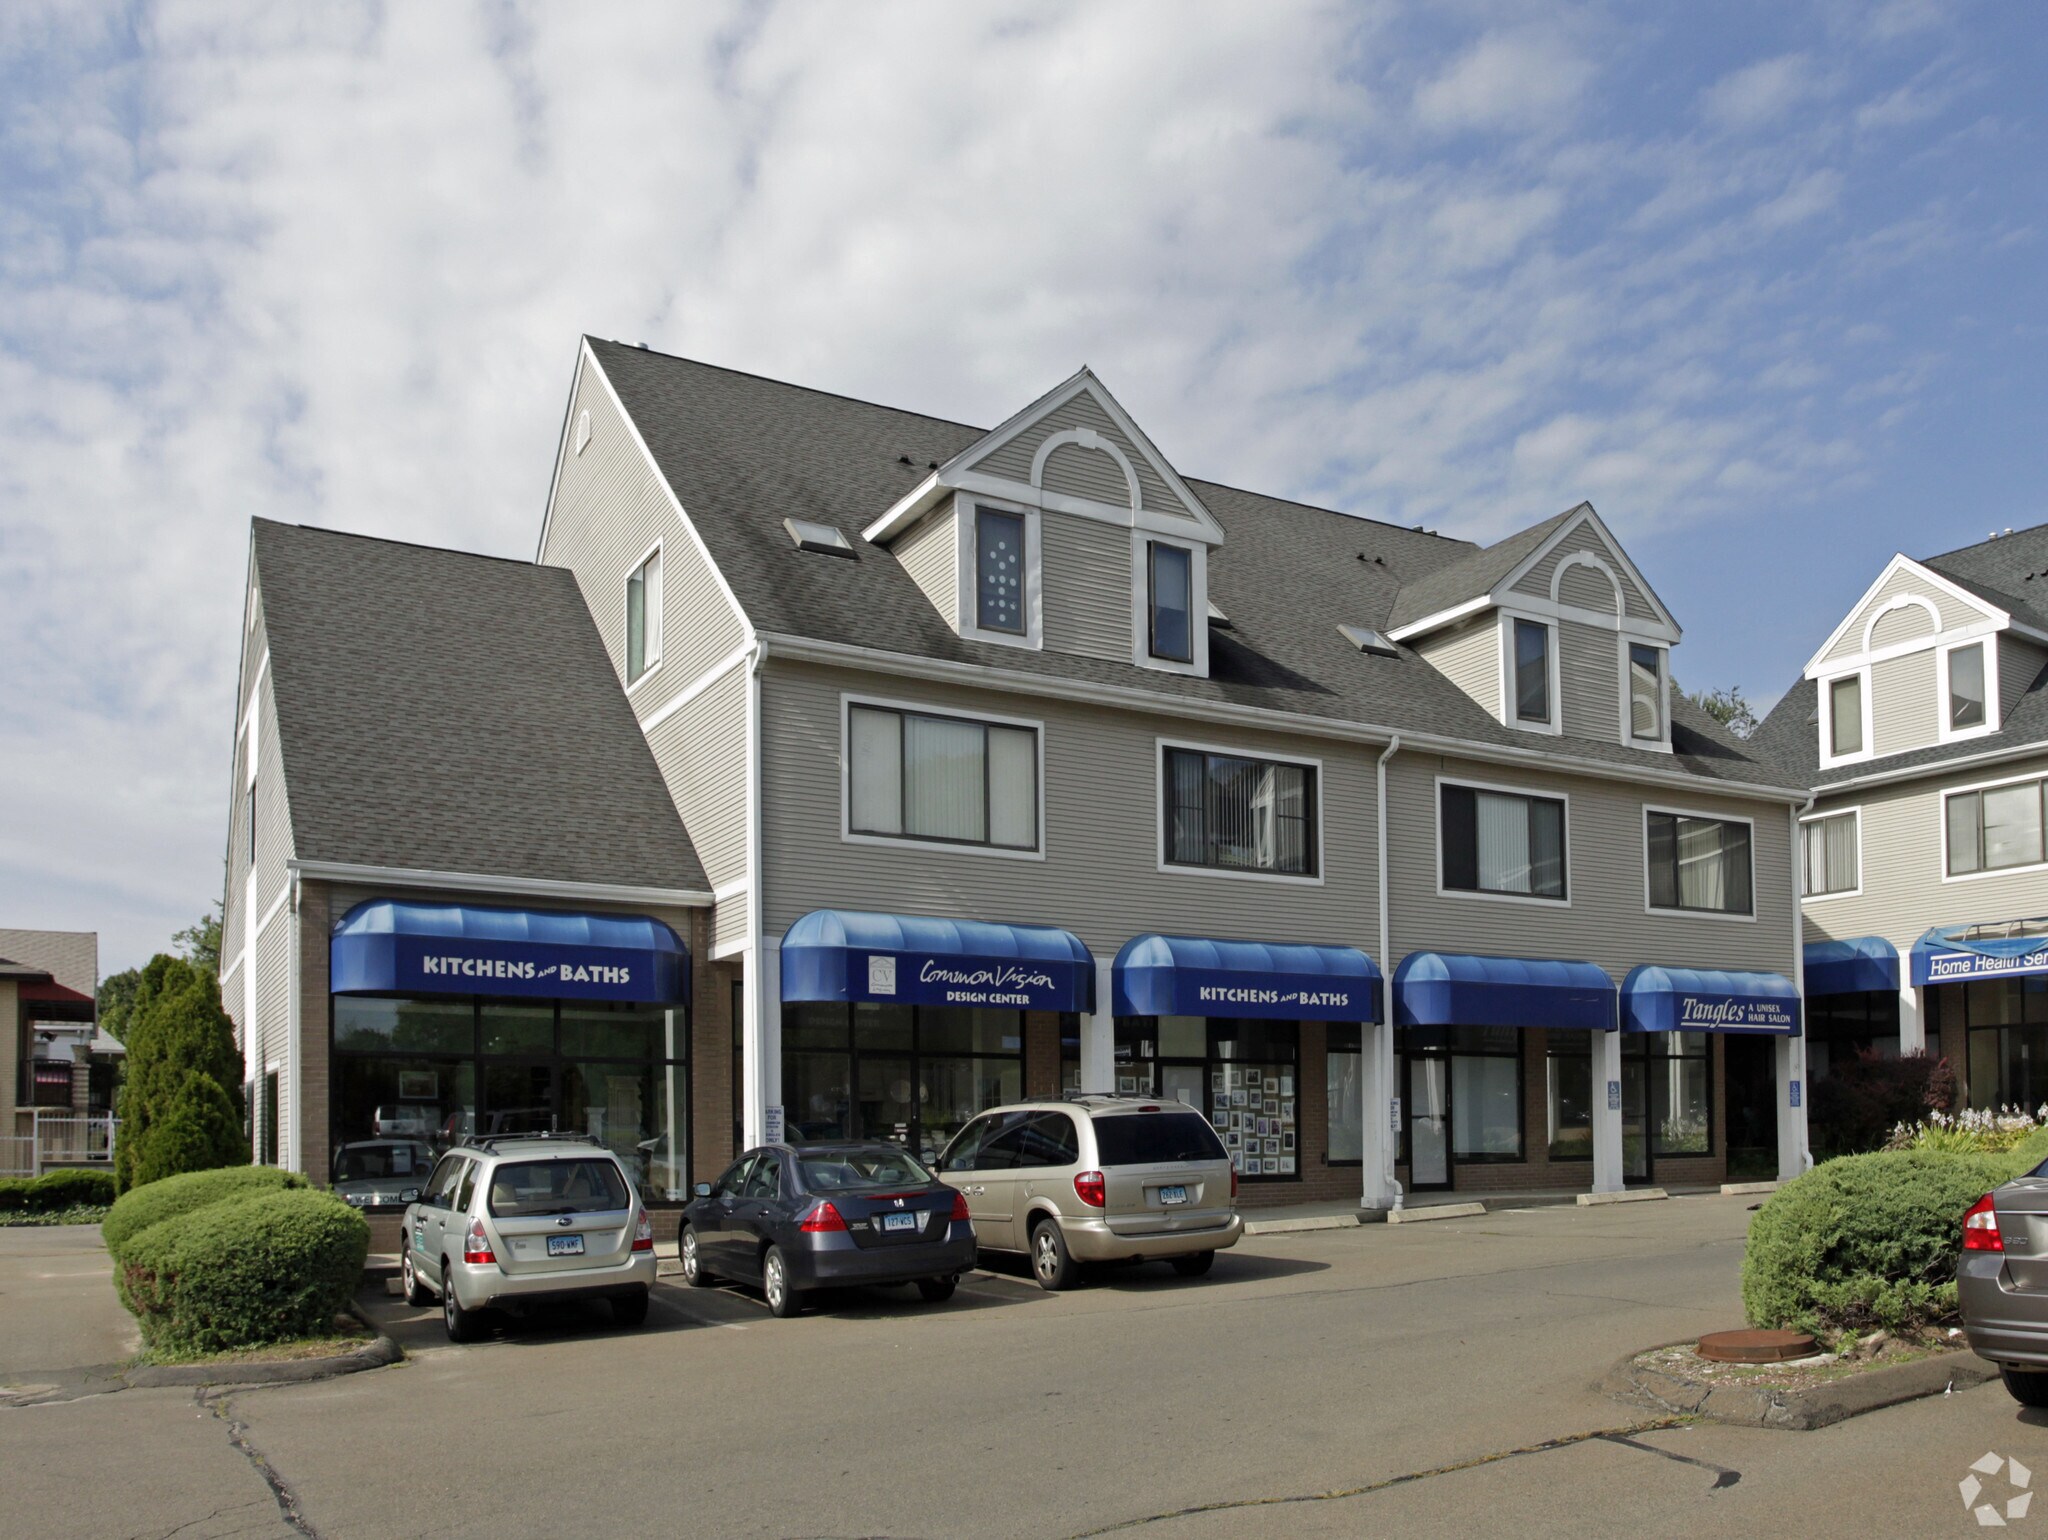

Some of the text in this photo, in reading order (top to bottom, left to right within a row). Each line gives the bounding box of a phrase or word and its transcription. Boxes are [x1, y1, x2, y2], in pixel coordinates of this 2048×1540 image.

[423, 956, 630, 984] KITCHENS AND BATHS
[1931, 960, 1971, 976] Home
[946, 991, 1030, 1005] DESIGN CENTER
[1200, 986, 1349, 1006] KITCHENS AND BATHS
[1682, 998, 1745, 1028] Tangles
[1748, 1003, 1781, 1013] A UNISEX
[1748, 1013, 1791, 1023] HAIR SALON
